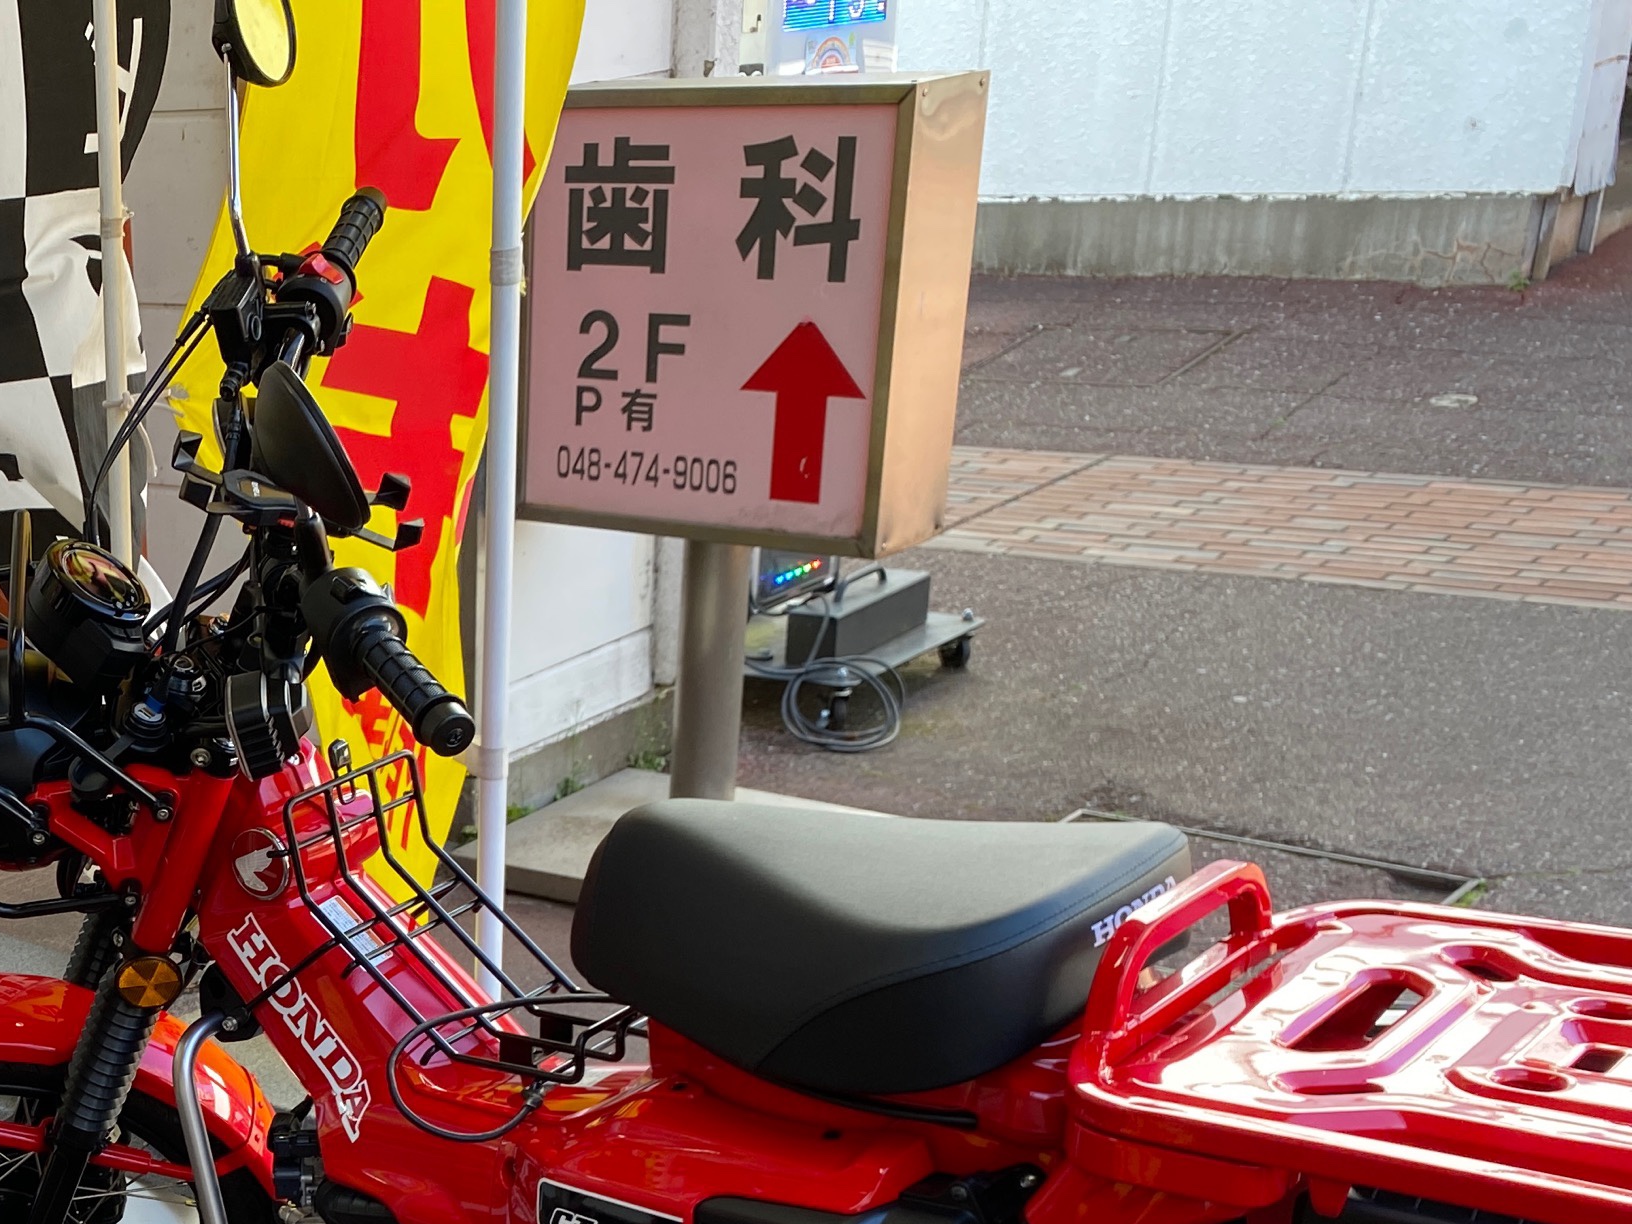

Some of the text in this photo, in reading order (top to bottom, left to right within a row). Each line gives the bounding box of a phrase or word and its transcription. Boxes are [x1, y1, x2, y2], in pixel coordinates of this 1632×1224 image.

[564, 134, 860, 283] 歯科
[576, 310, 691, 384] 2F
[556, 445, 737, 495] 048-474-9006
[227, 912, 371, 1143] HONDA
